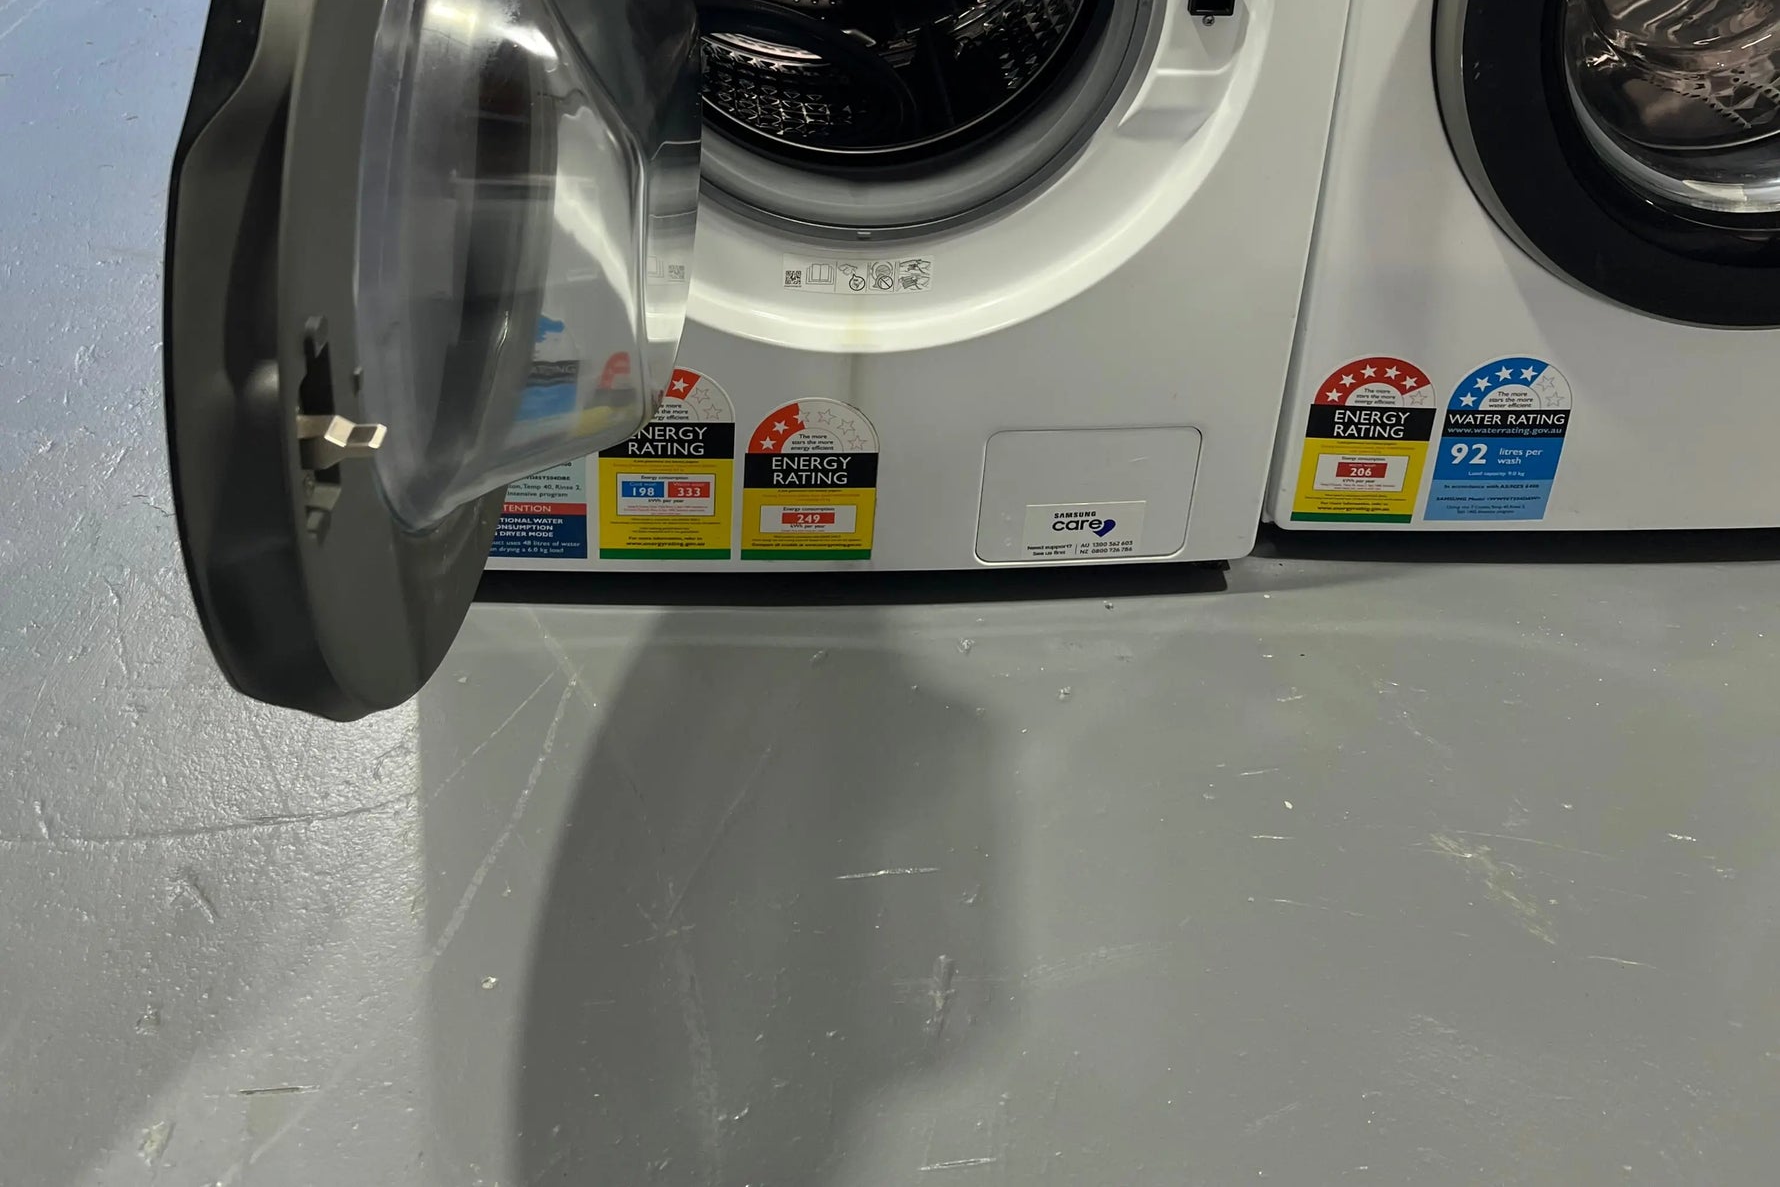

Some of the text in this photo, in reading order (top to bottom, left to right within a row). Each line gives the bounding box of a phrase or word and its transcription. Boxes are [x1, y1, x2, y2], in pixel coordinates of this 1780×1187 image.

[1334, 410, 1410, 424] ENERGY
[1449, 414, 1566, 425] WATER RATING
[1333, 425, 1405, 438] RATING
[1447, 427, 1562, 436] www.waterrating.gov.au
[628, 442, 704, 455] RATING
[1499, 448, 1543, 457] litres per
[1450, 443, 1488, 465] 92
[772, 457, 851, 469] ENERGY
[1497, 457, 1521, 465] wash
[1350, 467, 1372, 477] 206
[773, 472, 848, 485] RATING
[631, 487, 655, 497] 198
[677, 487, 701, 497] 333
[797, 514, 821, 523] 249
[1054, 511, 1097, 519] SAMSUNG
[1052, 519, 1103, 531] care
